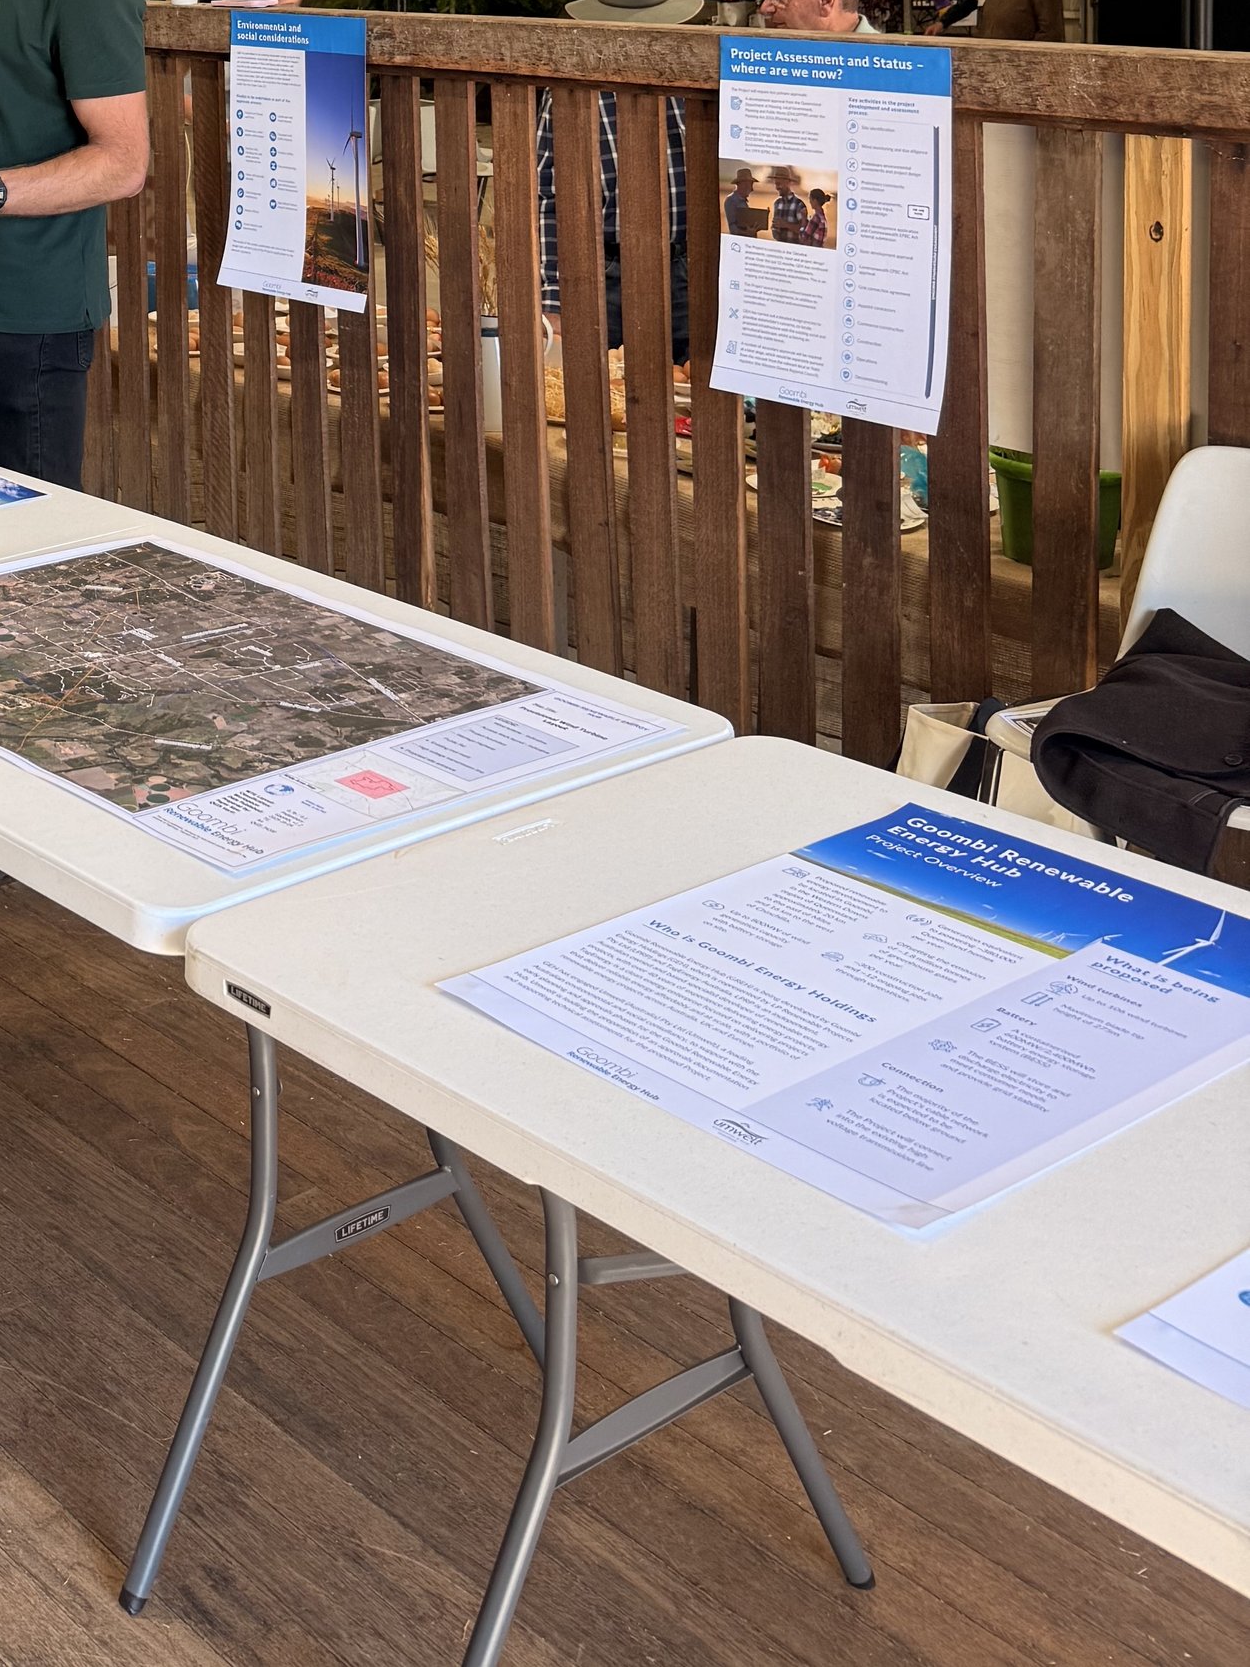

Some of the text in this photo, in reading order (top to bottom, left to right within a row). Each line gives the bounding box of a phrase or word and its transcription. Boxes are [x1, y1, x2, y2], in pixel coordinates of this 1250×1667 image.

[237, 20, 302, 33] Environmental and
[237, 32, 310, 45] social considerations
[730, 48, 772, 63] Project
[775, 50, 845, 66] Assessment
[847, 55, 869, 68] and
[873, 56, 913, 71] Status
[730, 62, 843, 80] where are we now?
[163, 807, 213, 833] Renewable
[211, 829, 244, 847] Energy
[176, 802, 247, 836] Goombi
[865, 833, 1003, 889] Project Overview
[886, 824, 1023, 880] Energy Hub
[906, 816, 1135, 904] Goombi Renewable
[649, 919, 877, 1023] Who is Goombi Energy Holdings
[1090, 961, 1173, 994] proposed
[1106, 955, 1220, 1003] What is being
[230, 986, 267, 1013] LIFETIME
[1066, 974, 1142, 1008] Wind turbines
[995, 1006, 1037, 1026] Battery
[567, 1050, 660, 1102] Renewable Energy Hub
[575, 1045, 639, 1080] Goombi
[881, 1062, 944, 1093] Connection
[341, 1210, 385, 1238] LIFETIME
